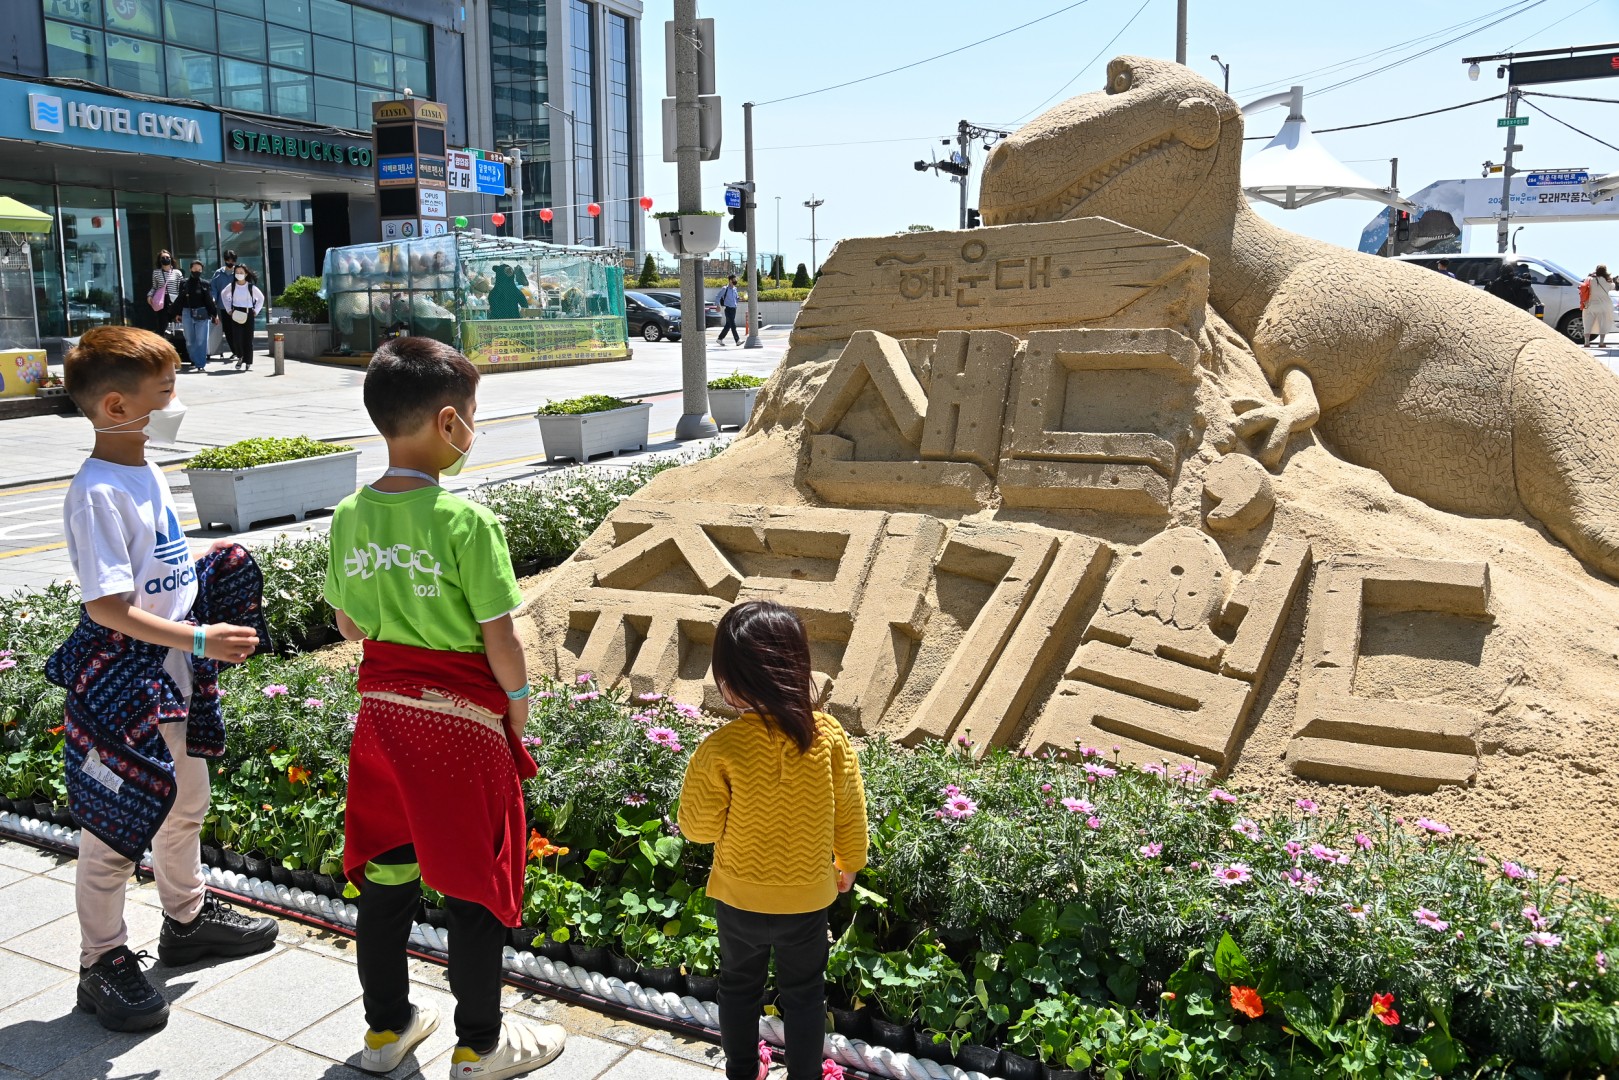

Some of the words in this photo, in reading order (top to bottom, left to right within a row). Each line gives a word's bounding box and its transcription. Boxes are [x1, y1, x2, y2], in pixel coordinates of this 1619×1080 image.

[67, 101, 139, 136] HOTEL
[138, 111, 203, 144] ELYSIA
[380, 108, 407, 118] ELYSIA
[421, 109, 442, 119] ELYSIA
[232, 129, 344, 164] STARBUCKS
[424, 192, 439, 200] OPUS
[875, 238, 1053, 308] 해운대
[804, 328, 1200, 515] 샌드
